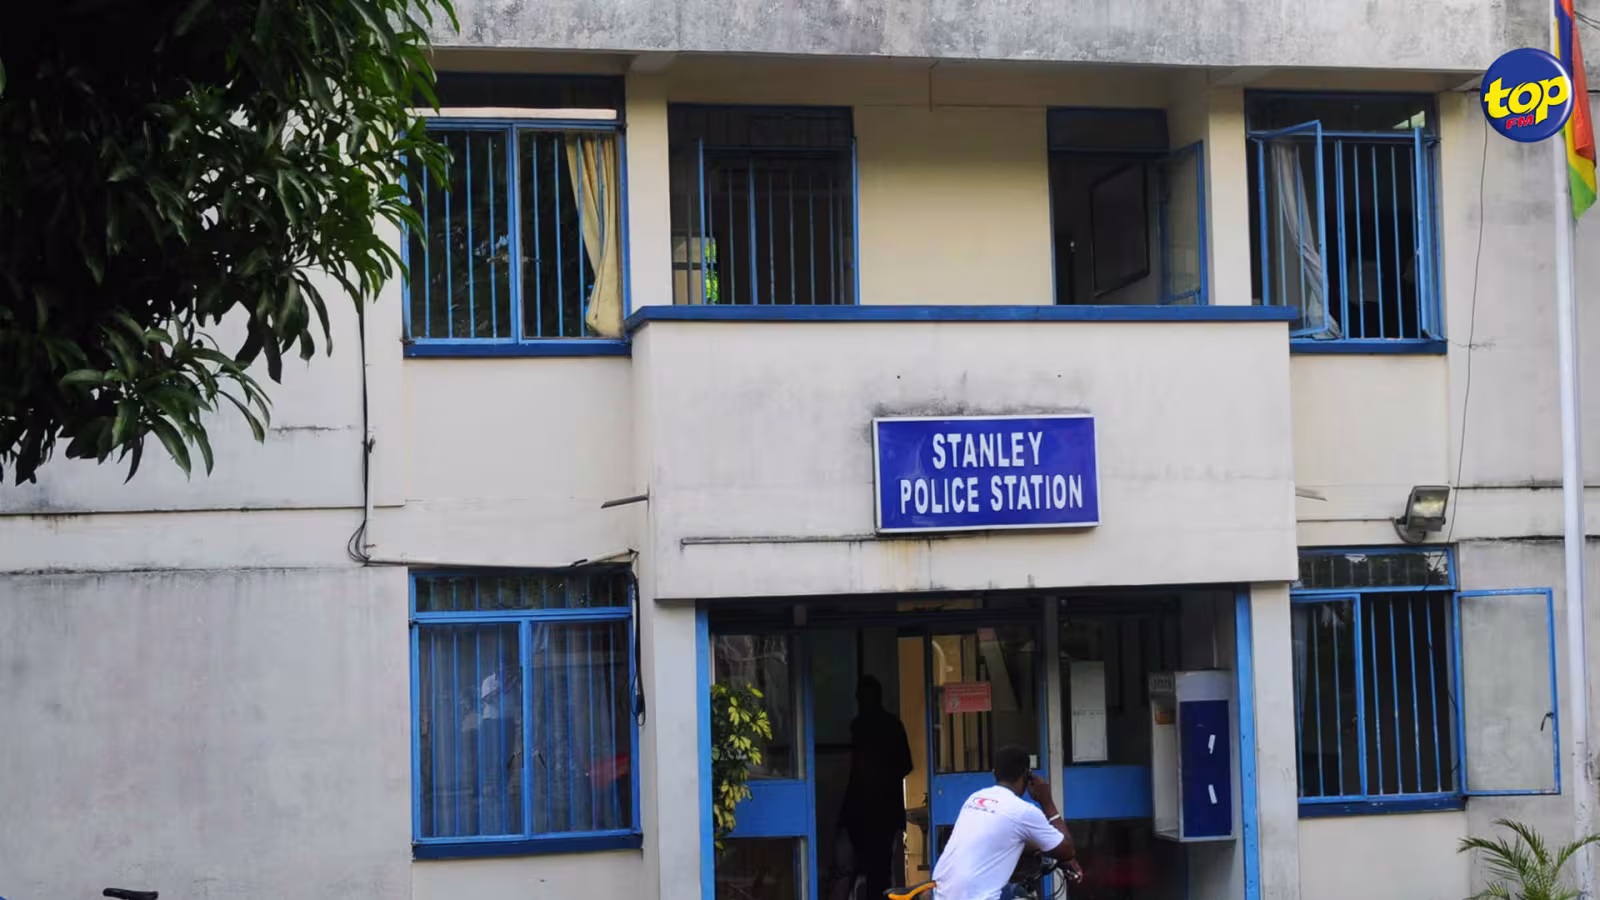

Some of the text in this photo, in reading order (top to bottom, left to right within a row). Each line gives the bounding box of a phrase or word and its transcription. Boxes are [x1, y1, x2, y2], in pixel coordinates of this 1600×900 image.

[932, 431, 1043, 469] STANLEY
[900, 474, 1083, 514] POLICE STATION
